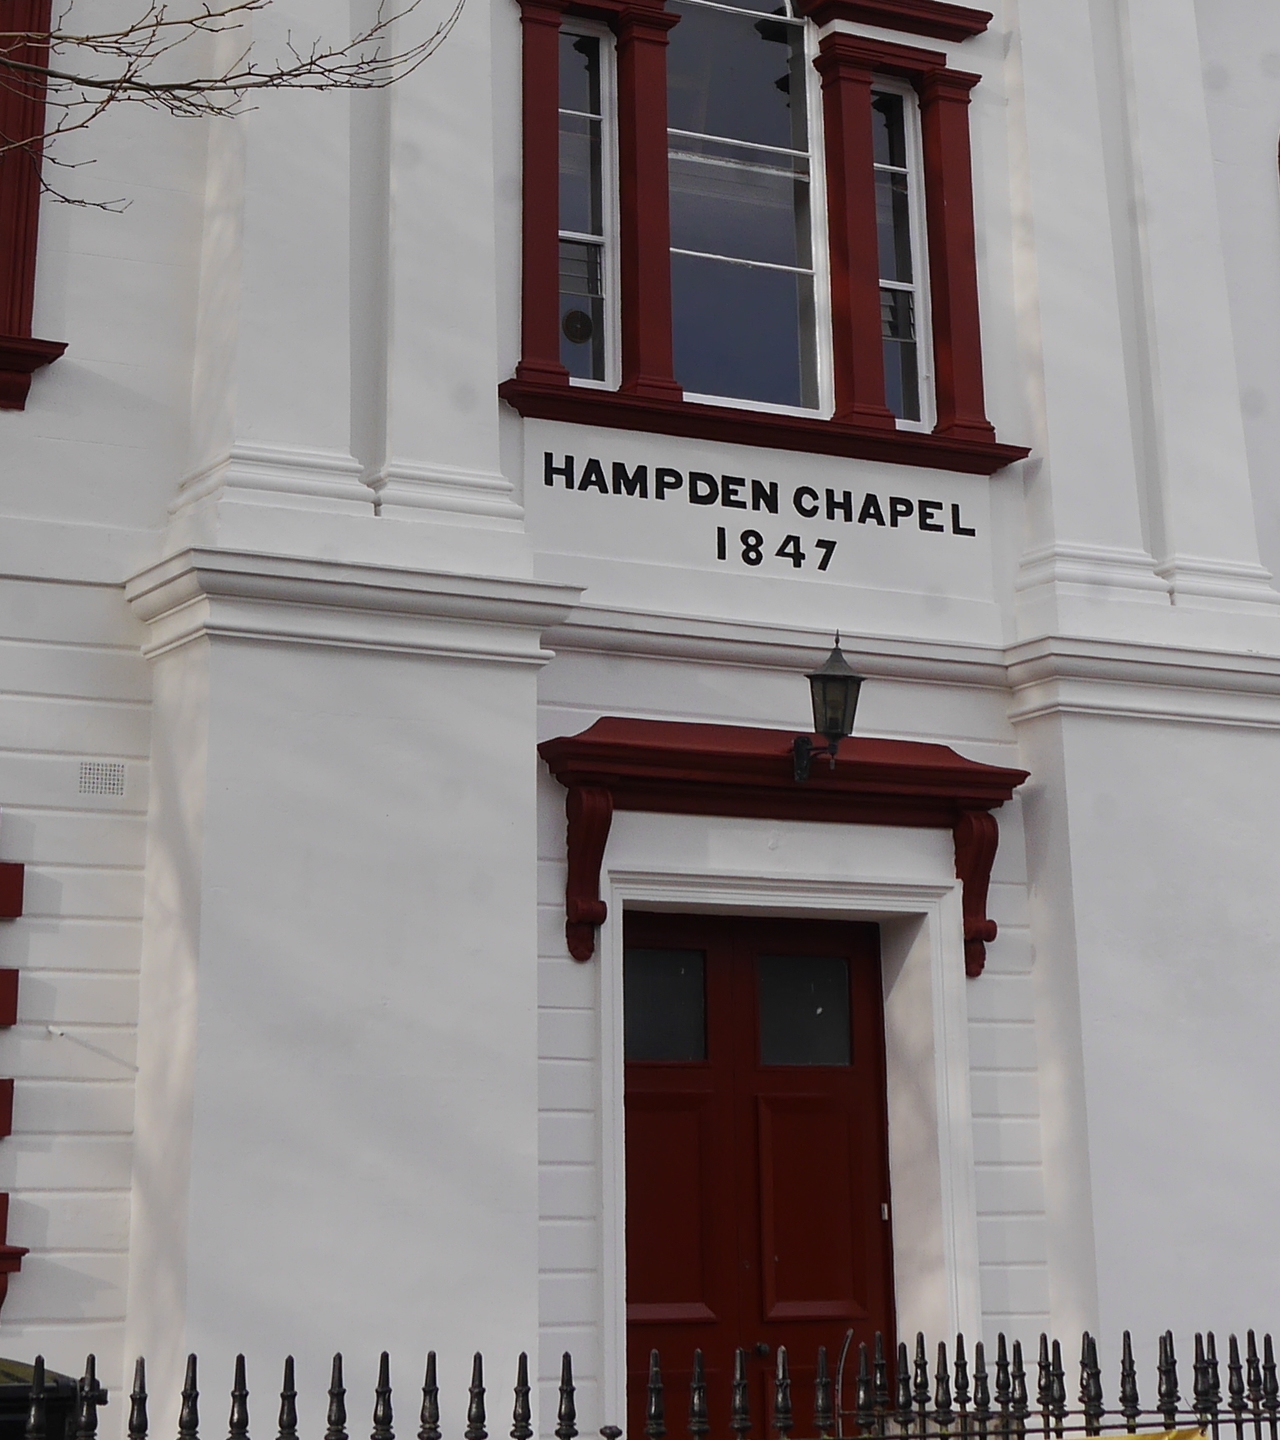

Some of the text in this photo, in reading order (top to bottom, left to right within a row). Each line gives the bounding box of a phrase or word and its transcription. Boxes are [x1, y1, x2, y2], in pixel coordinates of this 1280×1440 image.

[543, 451, 976, 537] HAMPDEN CHAPEL
[716, 526, 838, 572] 1847
